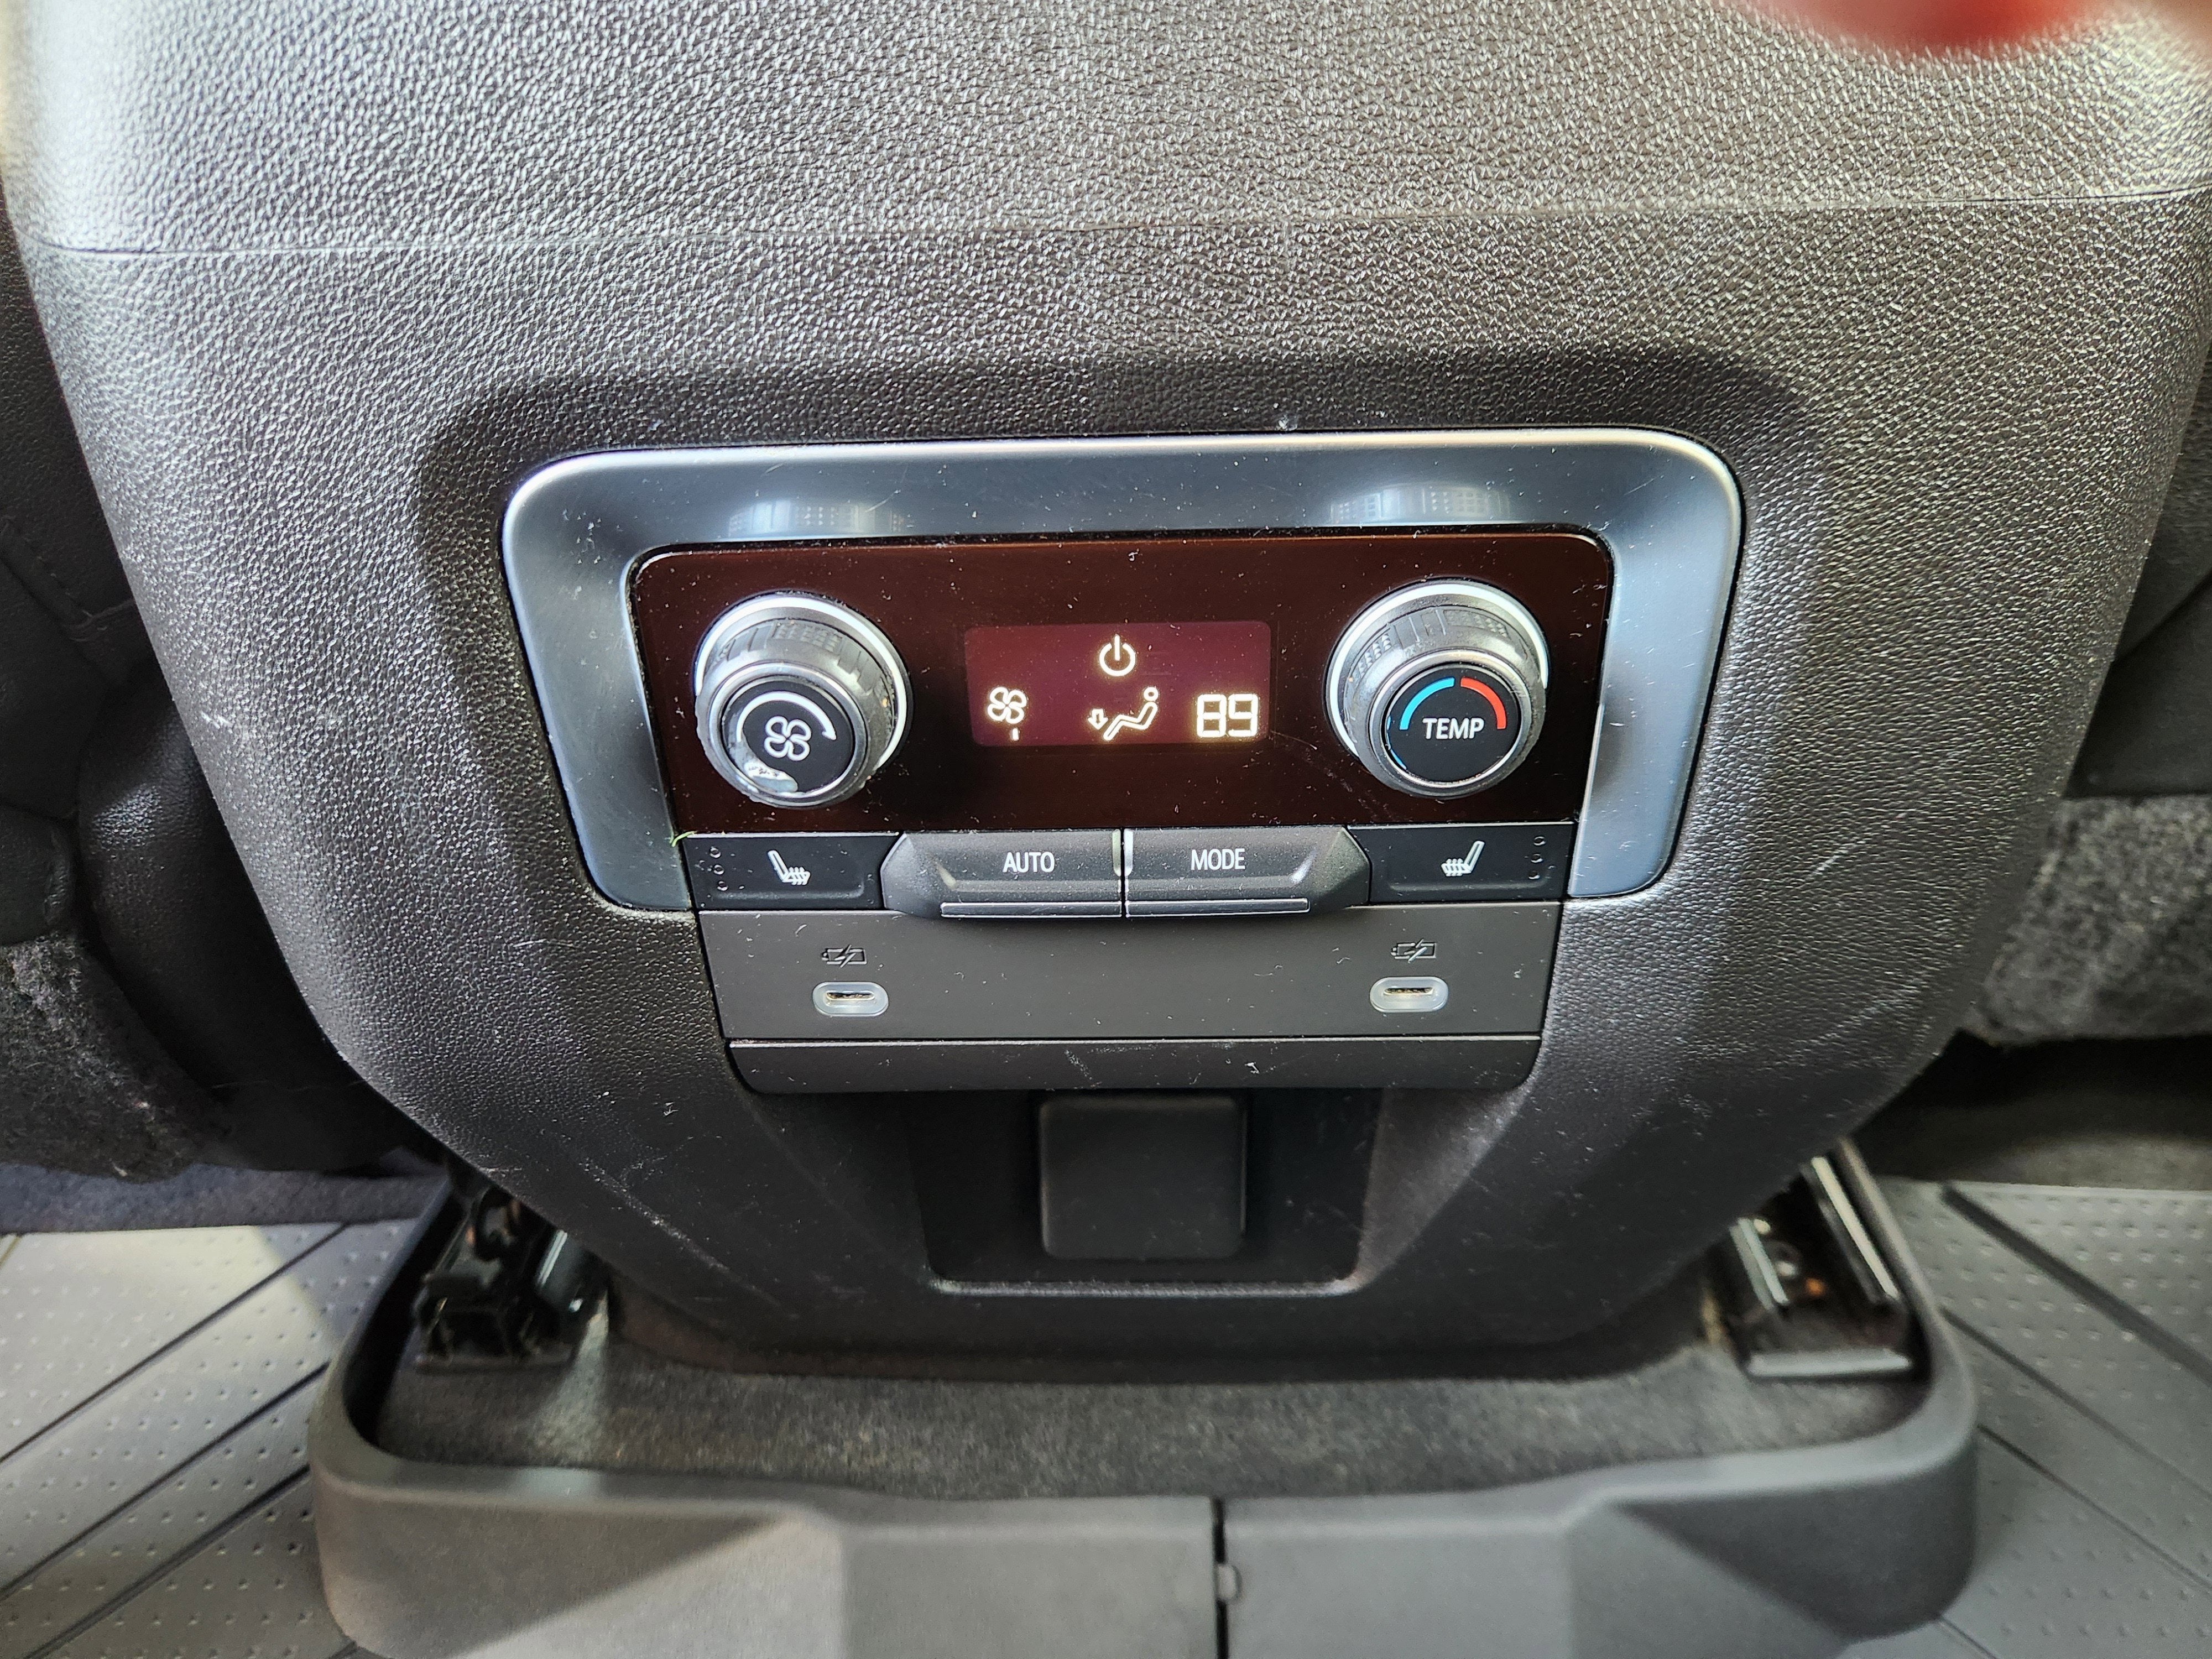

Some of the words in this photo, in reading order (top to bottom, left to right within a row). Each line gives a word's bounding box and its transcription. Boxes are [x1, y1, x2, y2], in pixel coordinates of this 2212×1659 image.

[1196, 693, 1259, 738] 89
[1422, 717, 1485, 740] TEMP
[1002, 851, 1056, 873] AUTO
[1191, 848, 1246, 871] MODE
